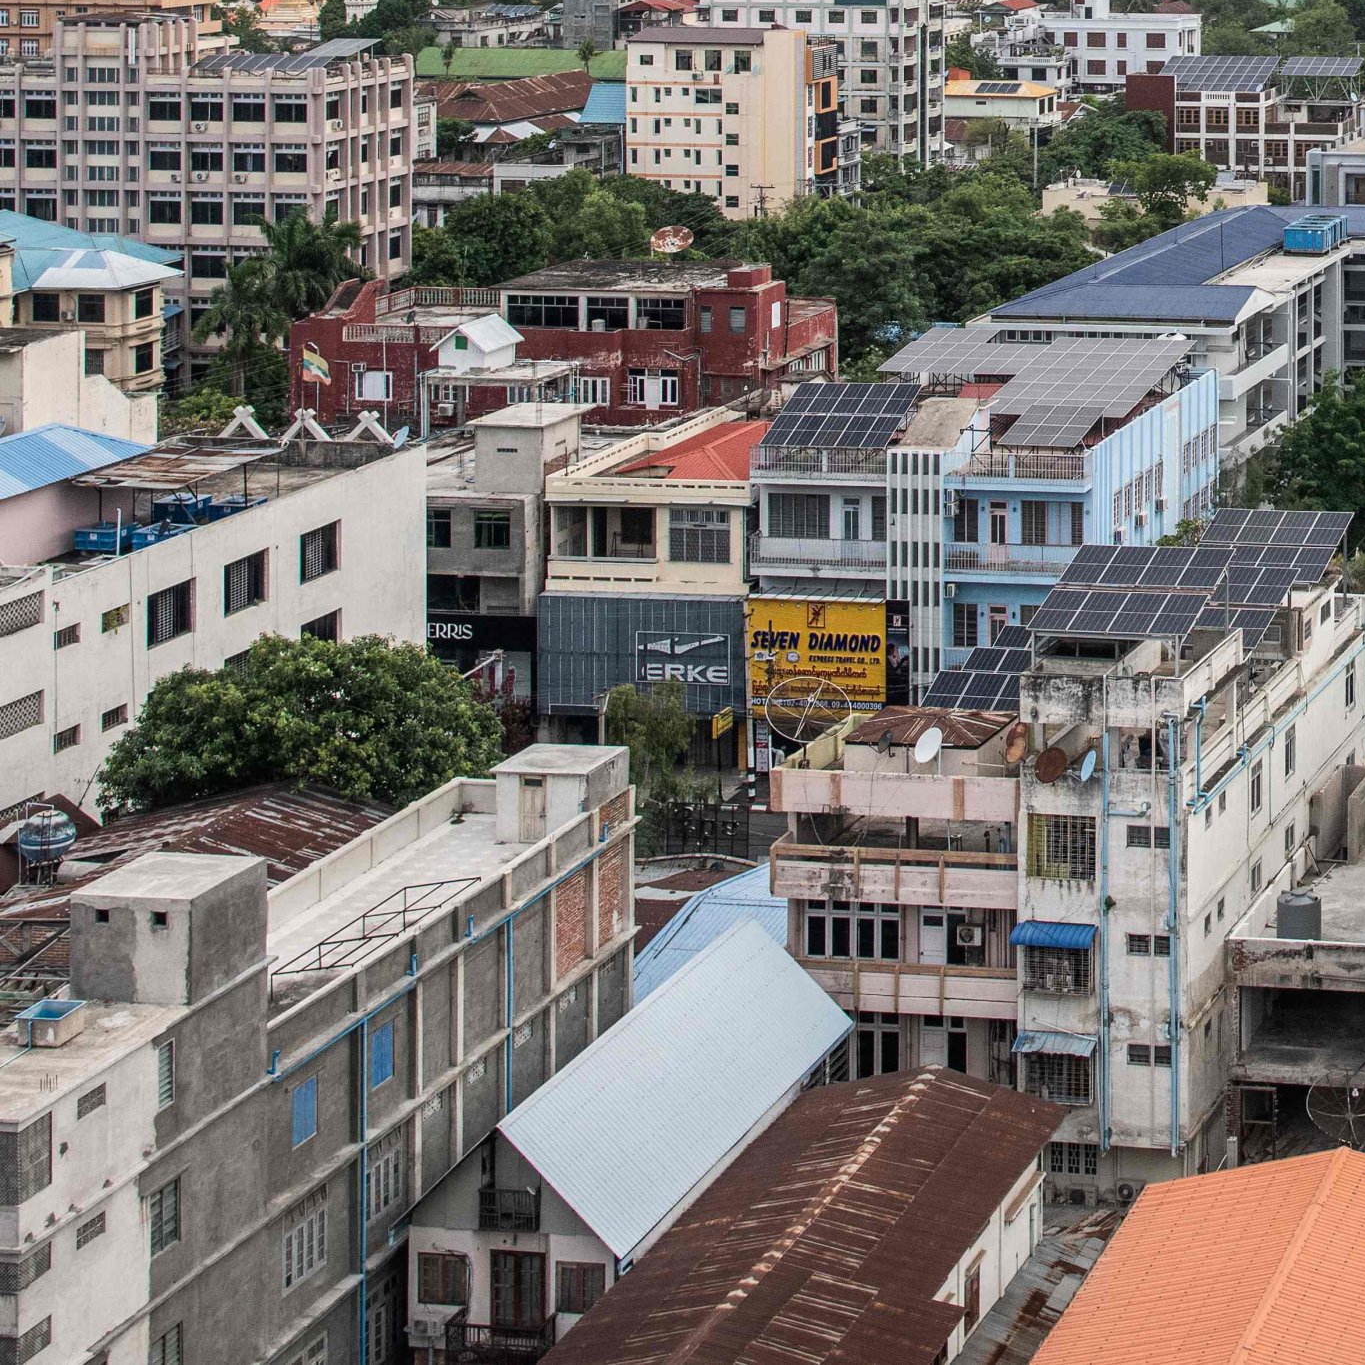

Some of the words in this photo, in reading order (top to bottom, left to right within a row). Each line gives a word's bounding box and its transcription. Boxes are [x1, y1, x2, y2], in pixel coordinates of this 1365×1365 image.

[751, 630, 800, 650] SEVEN
[808, 632, 881, 652] DIAMOND
[641, 663, 728, 684] ERKE
